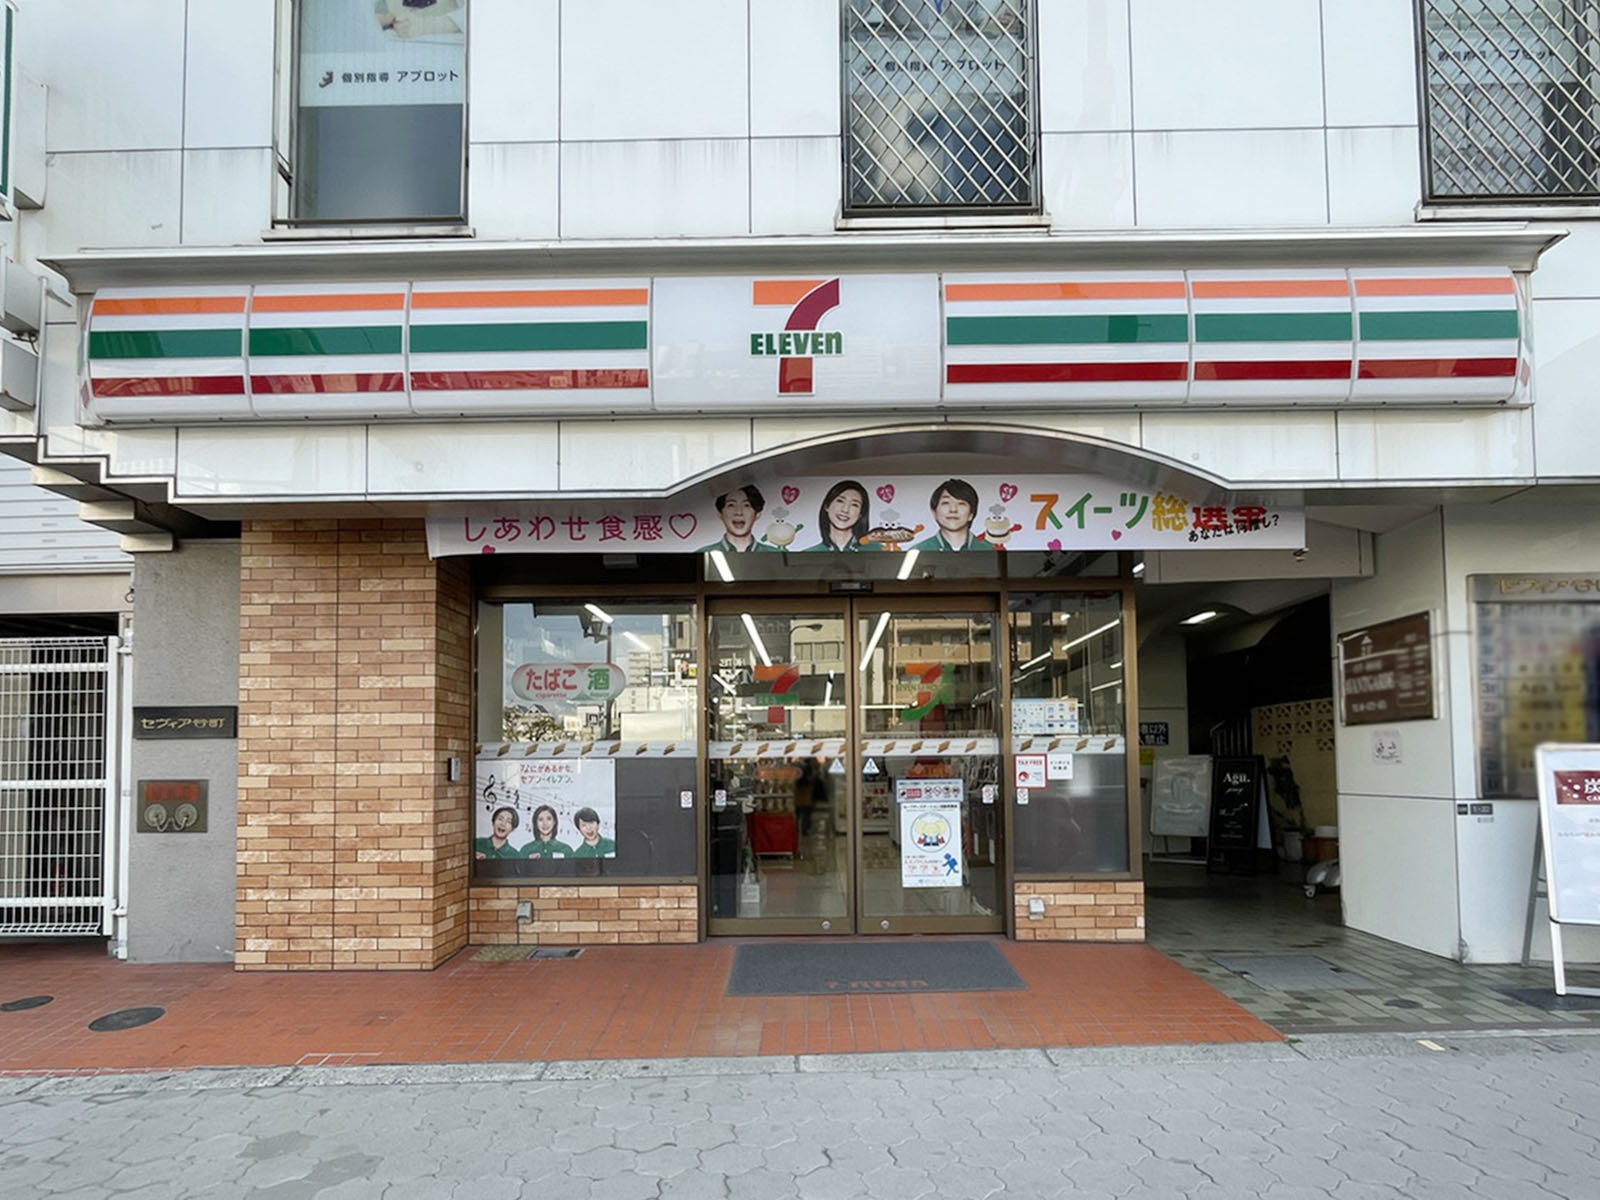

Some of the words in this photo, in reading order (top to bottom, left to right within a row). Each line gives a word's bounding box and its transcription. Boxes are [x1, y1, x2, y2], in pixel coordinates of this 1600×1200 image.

[525, 668, 578, 691] たばこ
[588, 668, 611, 691] 酒
